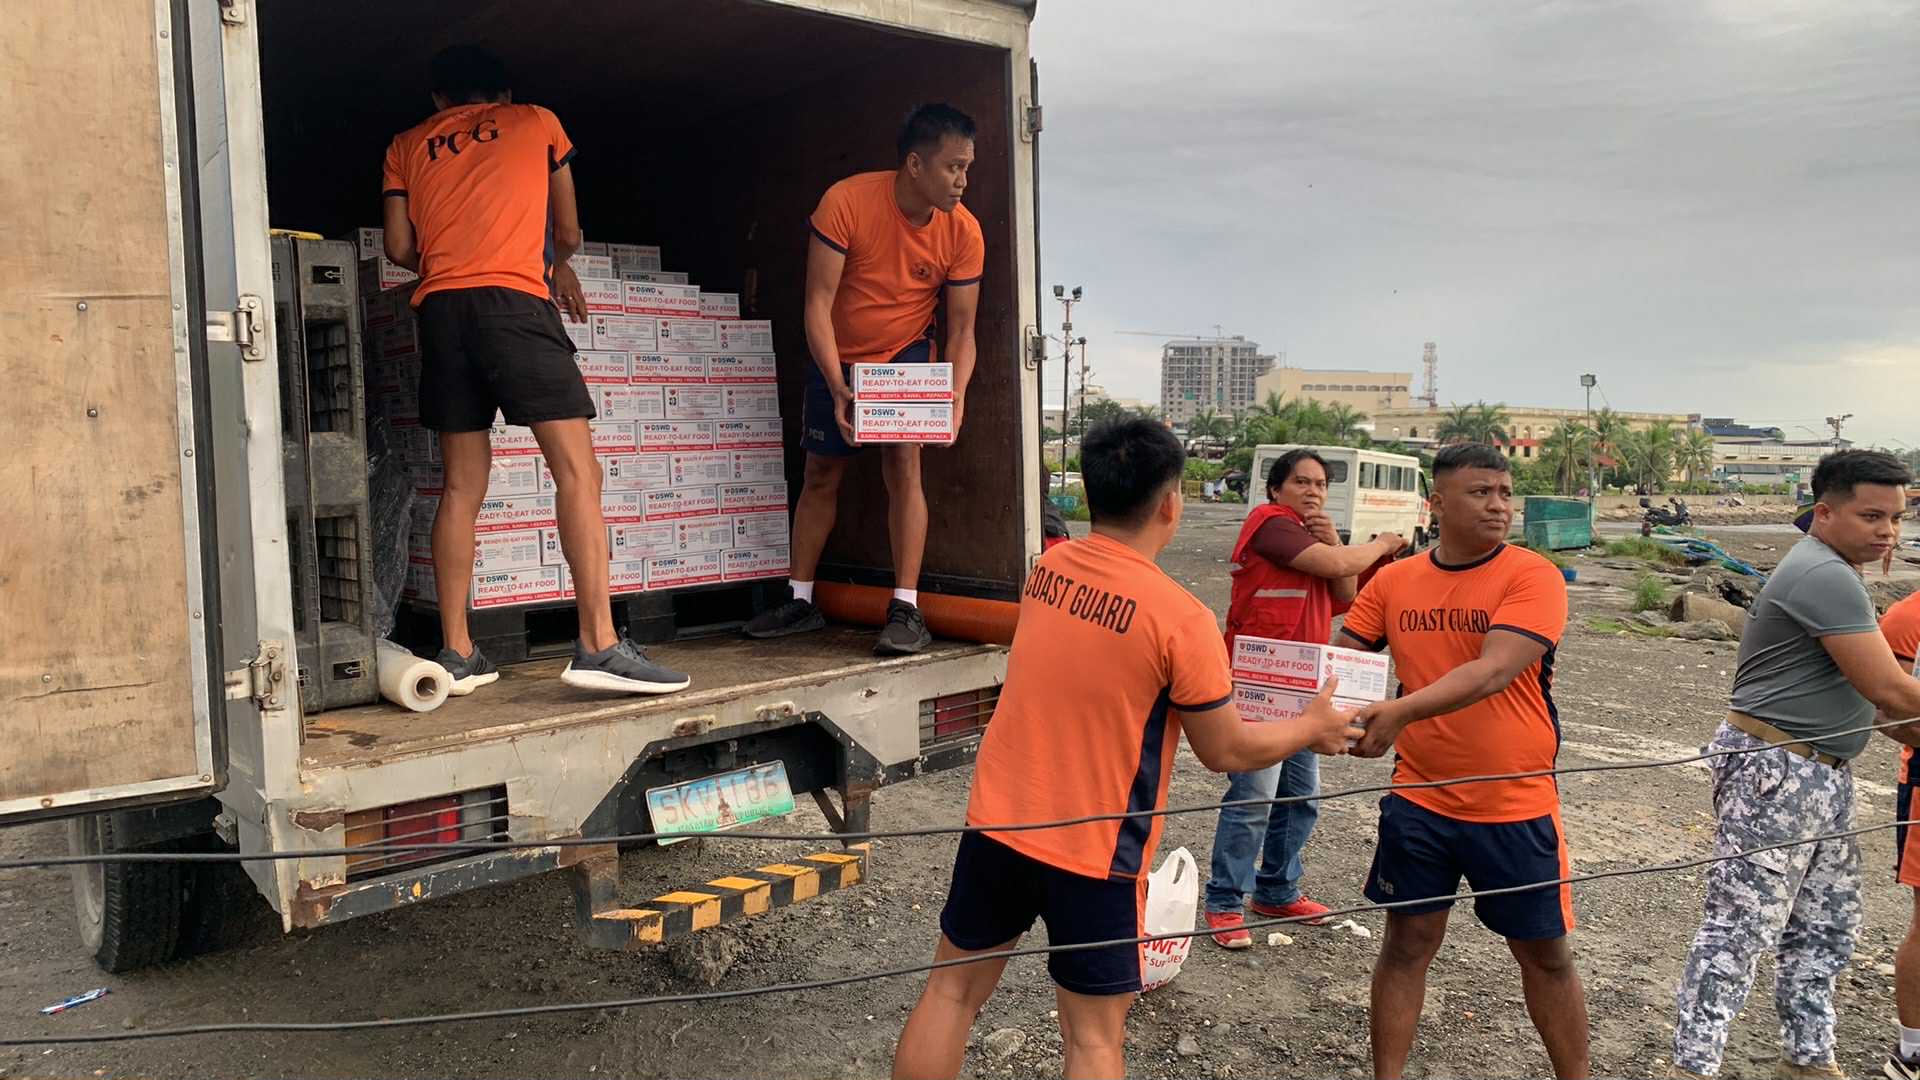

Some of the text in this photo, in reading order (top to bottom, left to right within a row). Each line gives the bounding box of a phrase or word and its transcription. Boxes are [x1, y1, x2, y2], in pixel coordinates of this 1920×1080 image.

[426, 119, 499, 162] PCG
[636, 286, 657, 294] DSWD
[678, 297, 698, 306] FOOD
[642, 355, 662, 363] DSWD
[604, 365, 625, 374] FOOD
[685, 365, 703, 373] FOOD
[871, 368, 896, 377] DSWD
[862, 379, 948, 387] READY-TO-EAT FOOD
[871, 408, 896, 417] DSWD
[651, 423, 671, 431] DSWD
[862, 419, 948, 428] READY-TO-EAT FOOD
[692, 432, 711, 440] FOOD
[654, 492, 674, 500] DSWD
[481, 500, 504, 510] DSWD
[618, 504, 637, 513] FOOD
[648, 497, 716, 511] READY-TO-EAT FOOD
[479, 508, 552, 521] EADY-TO-EAT FOOD
[658, 559, 678, 568] DSWD
[651, 563, 717, 578] READY-TO-EAT FOOD
[486, 574, 509, 583] DSWD
[620, 572, 640, 581] FOOD
[478, 578, 556, 594] READY-TO-EAT FOOD
[1025, 564, 1137, 634] COAST GUARD
[1399, 608, 1490, 634] COAST GUARD
[1246, 642, 1268, 654] DSWD
[1237, 655, 1315, 672] READY-TO-EAT FOOD
[1244, 690, 1266, 702] DSWD
[1235, 702, 1305, 720] READY-TO-EAT FO
